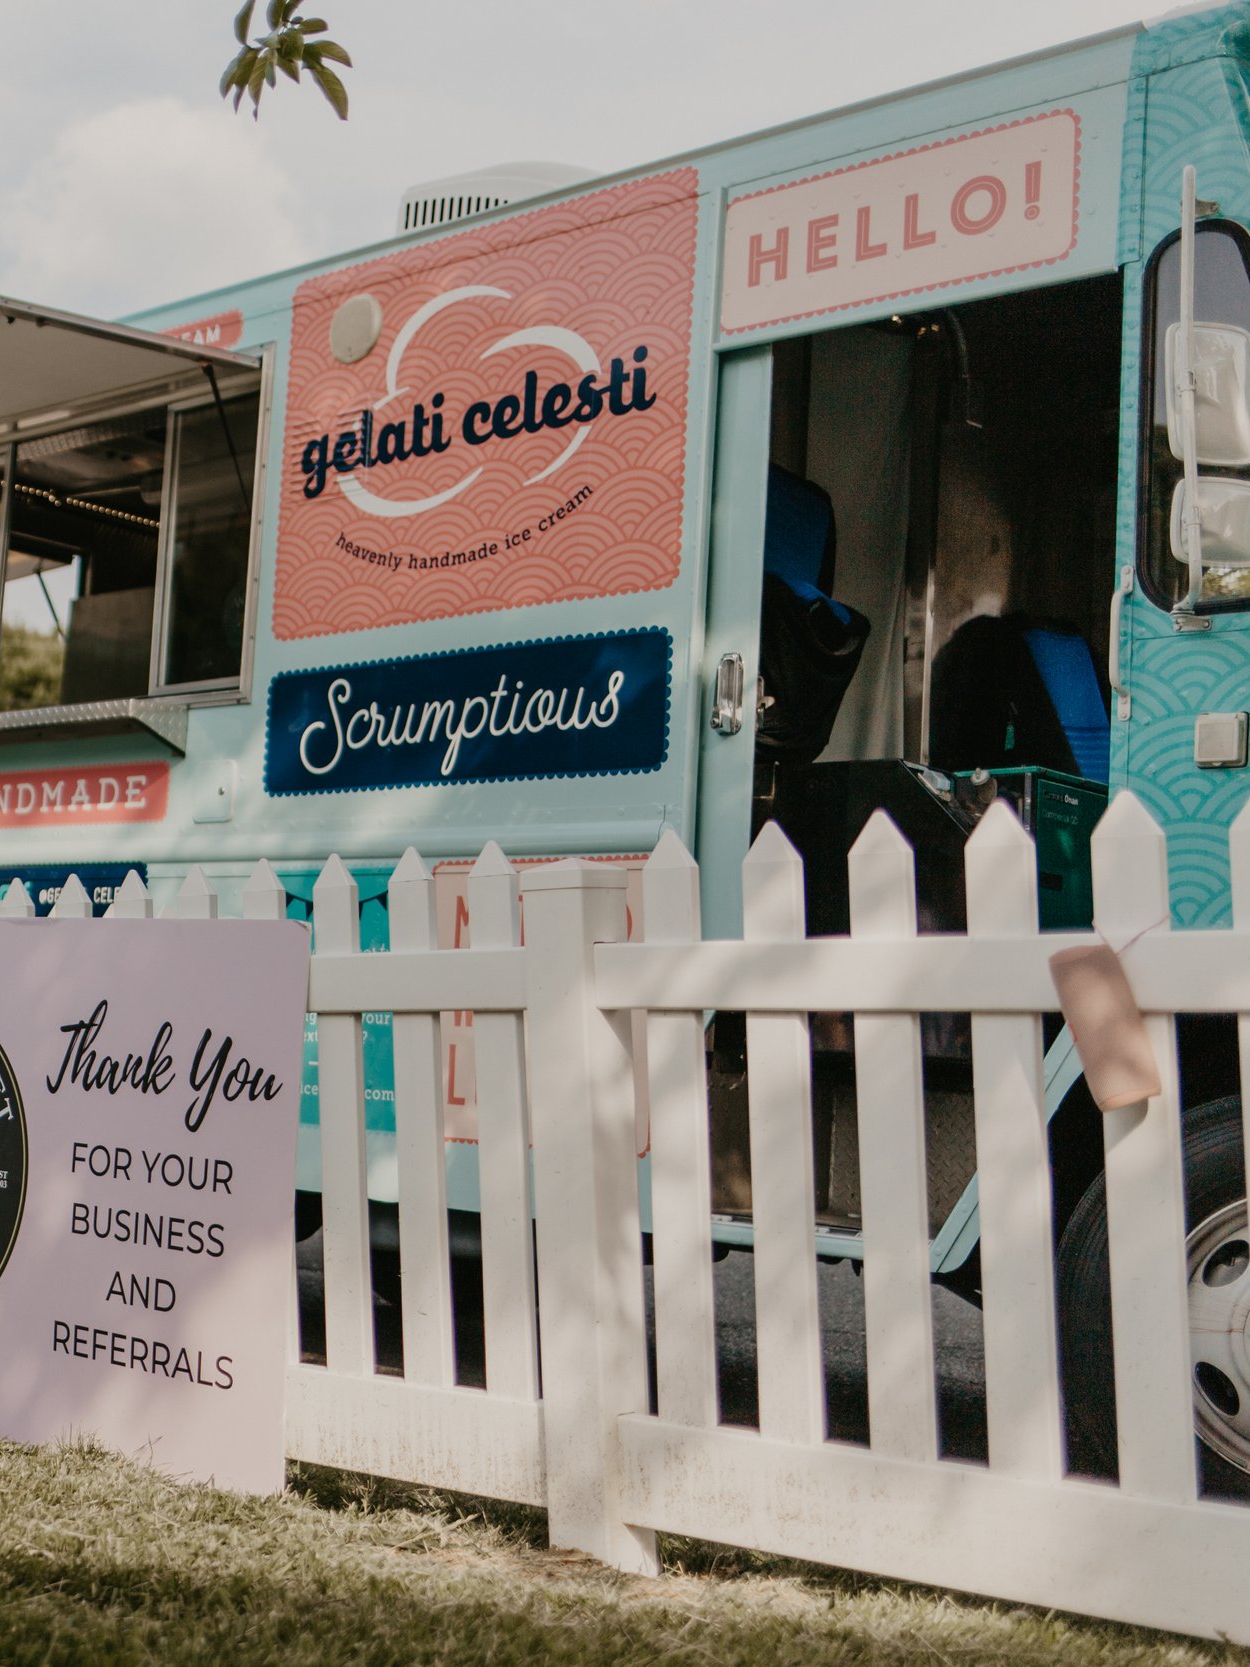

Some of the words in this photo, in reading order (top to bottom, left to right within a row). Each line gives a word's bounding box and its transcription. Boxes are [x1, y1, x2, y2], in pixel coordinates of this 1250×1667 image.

[747, 160, 1042, 287] HELLO!
[301, 393, 450, 499] gelati
[462, 345, 657, 445] celesti
[335, 532, 402, 572] heavenly
[407, 543, 498, 570] handmade
[504, 529, 531, 551] ice
[538, 484, 594, 532] cream
[300, 670, 624, 776] Scrumptious
[47, 999, 175, 1095] Thank
[184, 1028, 283, 1132] You
[71, 1142, 132, 1181] FOR
[141, 1150, 233, 1194] YOUR
[71, 1202, 225, 1257] BUSINESS
[105, 1271, 176, 1312] AND
[53, 1320, 233, 1390] REFERRALS
